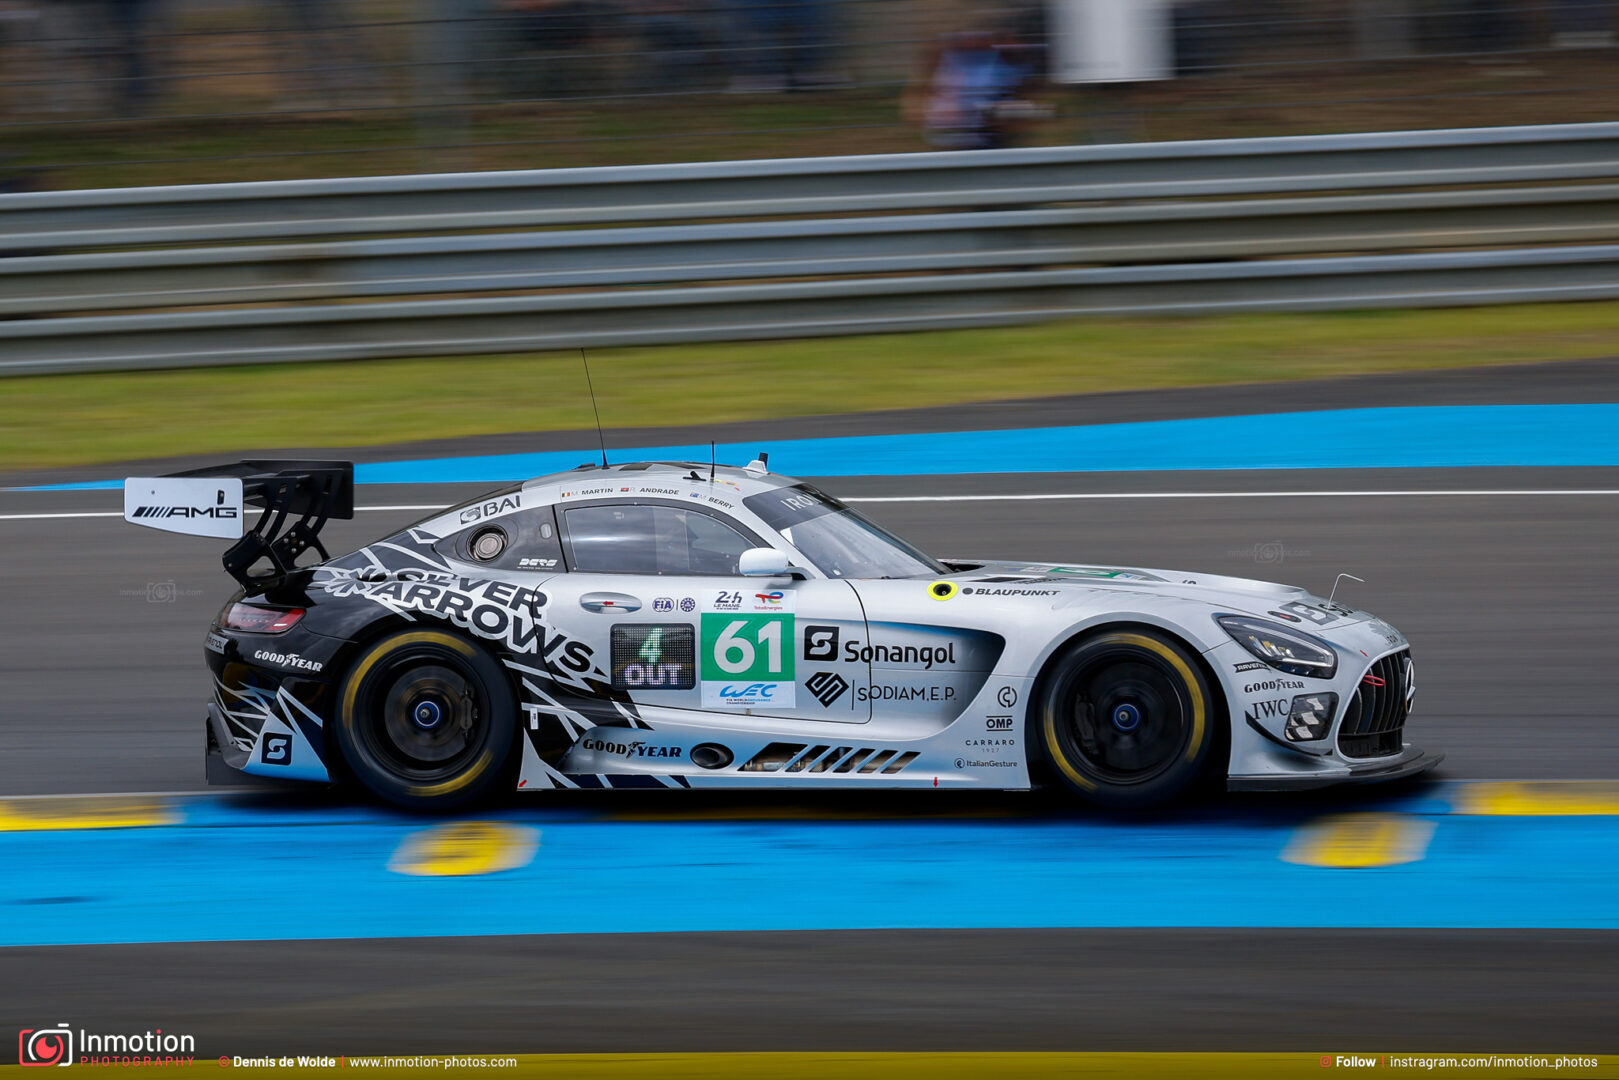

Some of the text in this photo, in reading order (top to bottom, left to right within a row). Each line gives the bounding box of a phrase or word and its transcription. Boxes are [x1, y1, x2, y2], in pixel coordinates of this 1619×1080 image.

[640, 487, 679, 495] ANDRADE
[166, 506, 238, 518] AMG
[483, 495, 521, 517] BAI
[708, 496, 735, 509] BERRY
[974, 588, 1061, 597] BLAUPUNKT
[371, 582, 595, 673] ARROWS
[638, 627, 663, 664] 4
[713, 620, 782, 674] 61
[844, 640, 956, 669] Sonangol
[254, 649, 323, 672] GOODYEAR
[624, 663, 683, 686] OUT
[719, 683, 777, 698] WEC
[1244, 678, 1304, 693] GOODYEAR
[1252, 699, 1290, 720] IWC
[986, 718, 1013, 729] OMP
[582, 737, 682, 759] GOODYEAR
[966, 760, 1018, 768] ItalianGesture
